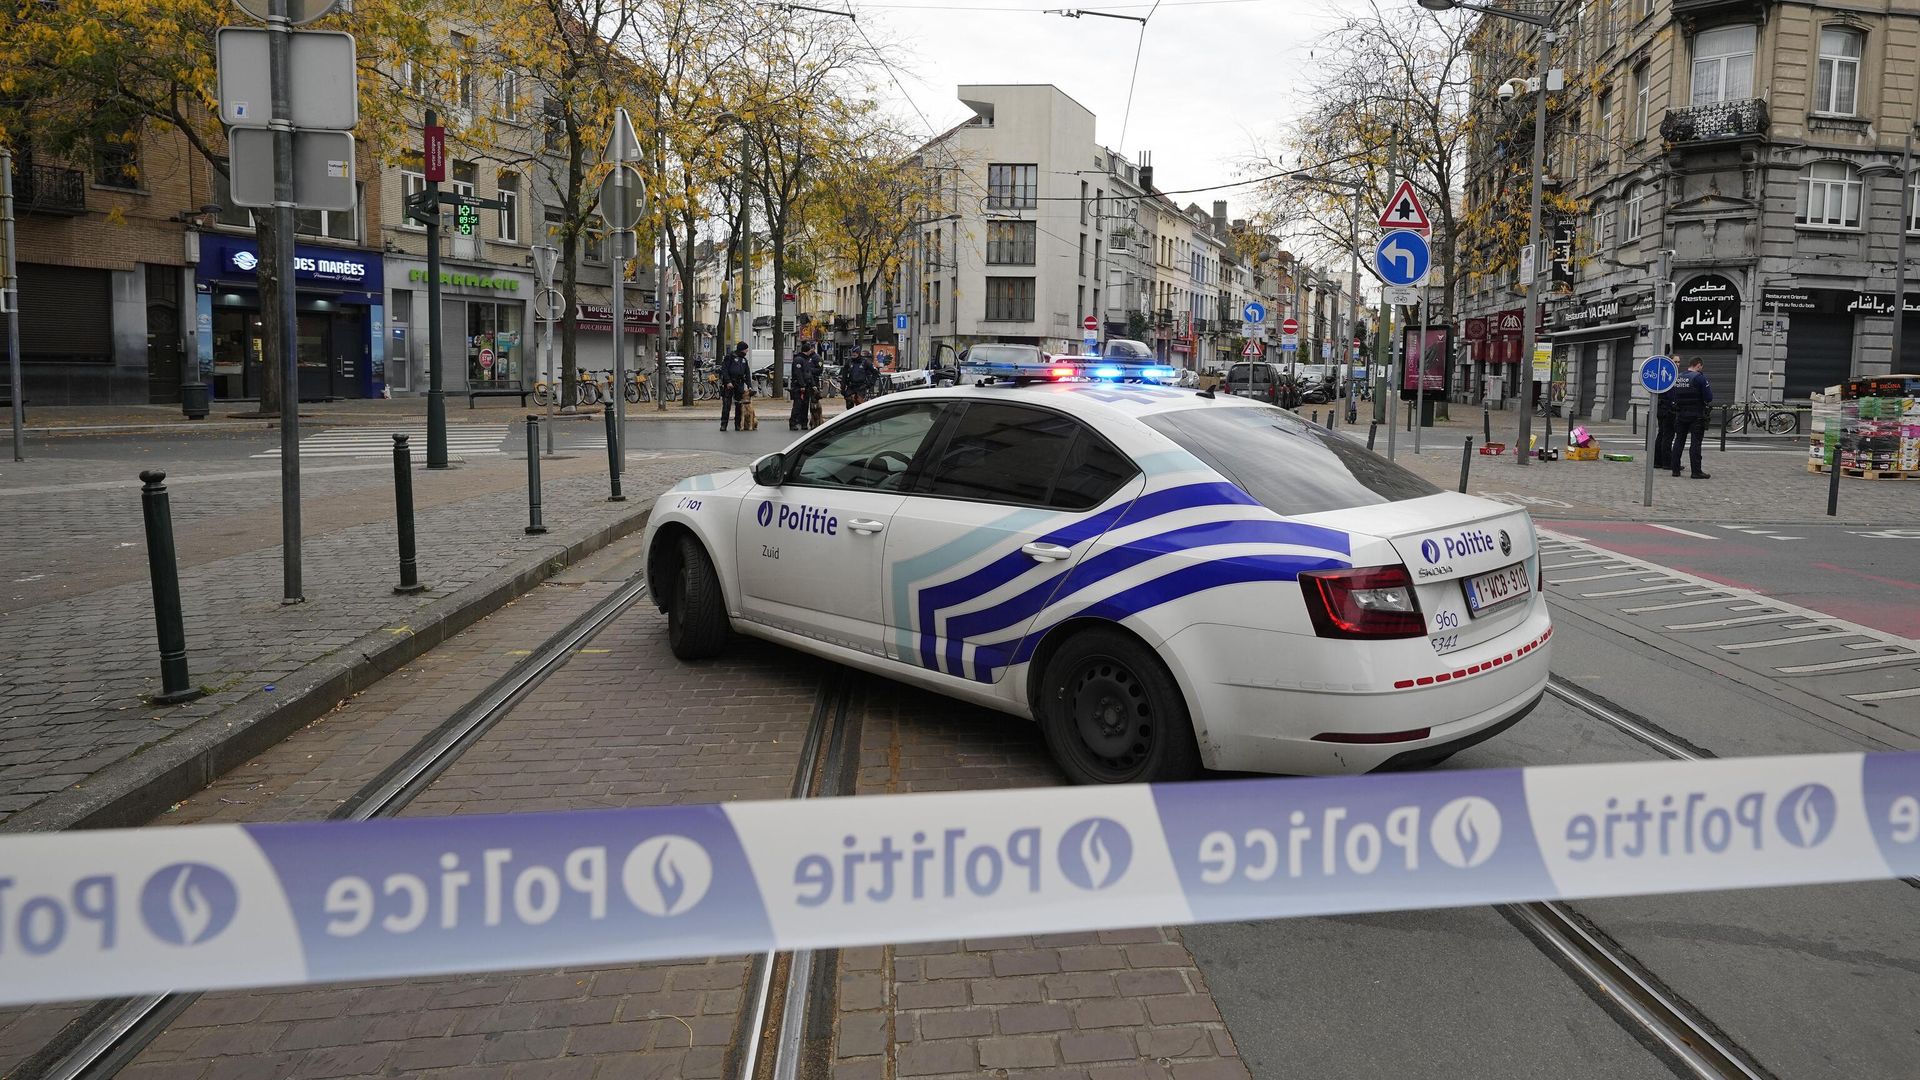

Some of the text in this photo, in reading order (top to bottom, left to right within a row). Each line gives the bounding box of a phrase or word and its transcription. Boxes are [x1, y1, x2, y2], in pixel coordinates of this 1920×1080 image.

[319, 260, 365, 276] MARÉES
[1689, 281, 1726, 294] مطعم
[1681, 294, 1734, 302] Restaurant
[1565, 310, 1588, 321] Restaurant
[1588, 307, 1597, 319] YA
[1597, 302, 1618, 318] CHAM
[1680, 309, 1732, 329] ياشام
[580, 323, 611, 332] BOUCHERIE
[1679, 332, 1734, 341] YA CHAM
[778, 504, 838, 536] Politie
[1444, 530, 1494, 558] Politie
[762, 545, 780, 560] Zuid
[1475, 567, 1527, 603] 1-WCB-910
[1471, 597, 1479, 608] B
[1435, 610, 1459, 630] 960
